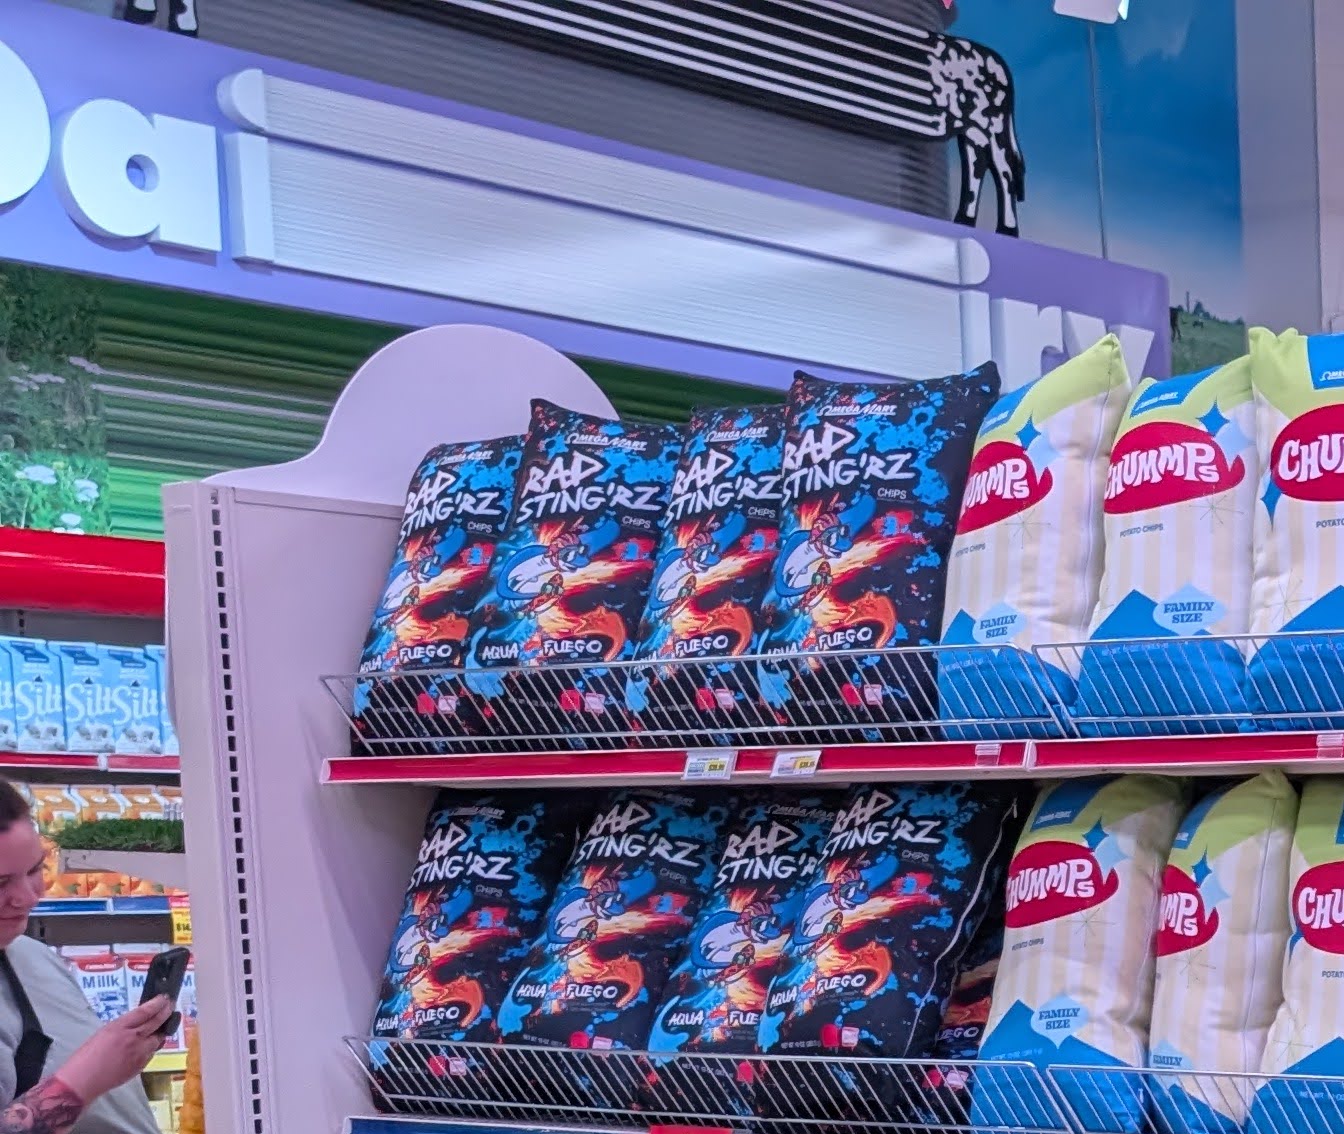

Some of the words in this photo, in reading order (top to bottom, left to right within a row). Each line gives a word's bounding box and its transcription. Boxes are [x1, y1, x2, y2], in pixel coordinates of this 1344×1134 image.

[784, 422, 855, 470] RAD
[523, 451, 603, 496] RAD
[516, 483, 666, 524] STING'RZ
[621, 515, 652, 530] CHIPS
[1164, 602, 1214, 616] FAMILY
[1172, 612, 1203, 624] SIZE
[543, 635, 603, 655] FUEGO
[818, 627, 873, 650] FUEGO
[481, 643, 518, 661] AQUA
[592, 804, 651, 837] RAD
[830, 792, 894, 831] RAD
[576, 834, 700, 867] STING'RZ
[819, 819, 942, 863] STING'RZ
[83, 976, 119, 989] Millk
[516, 983, 546, 999] AQUA
[566, 981, 618, 1001] FUEGO
[816, 973, 867, 994] FUEGO
